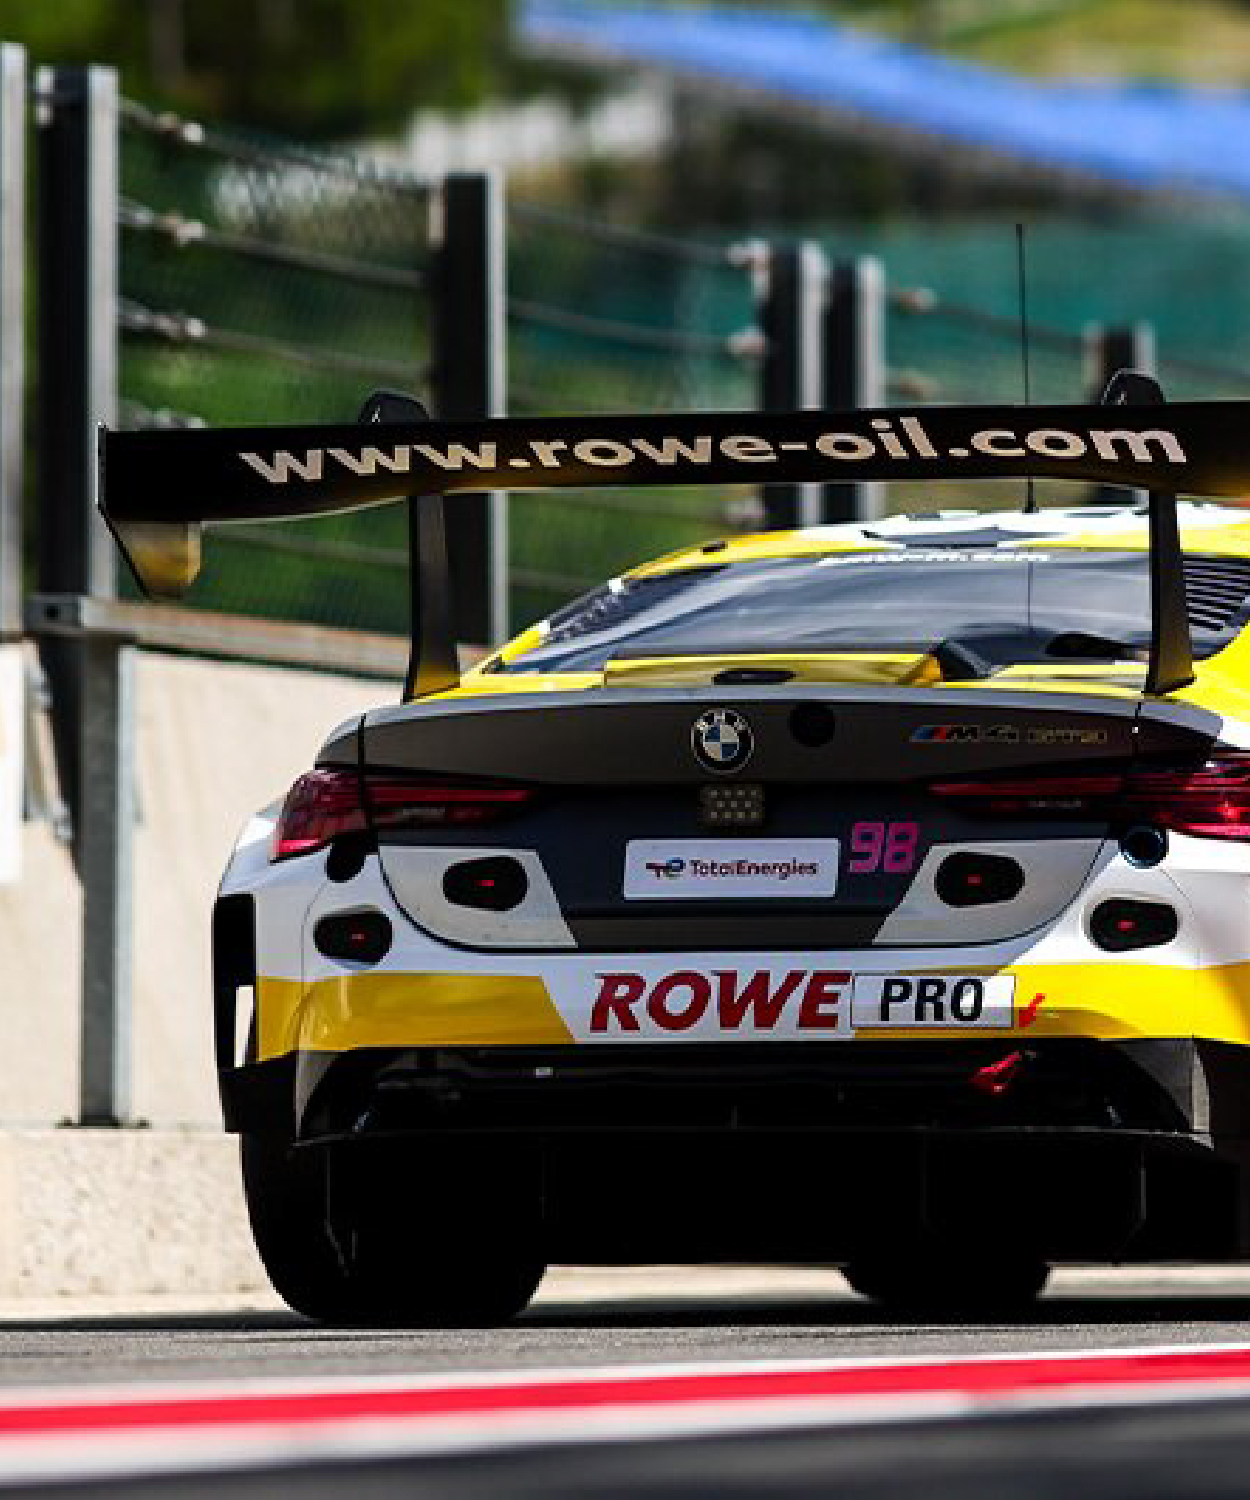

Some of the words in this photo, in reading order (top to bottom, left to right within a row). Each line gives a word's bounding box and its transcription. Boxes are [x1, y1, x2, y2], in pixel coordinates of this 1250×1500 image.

[238, 416, 1187, 483] www.rowe-oil.com
[690, 857, 820, 881] TotalEnergies
[850, 822, 919, 873] 98
[589, 970, 853, 1031] ROWE
[880, 978, 983, 1022] PRO
